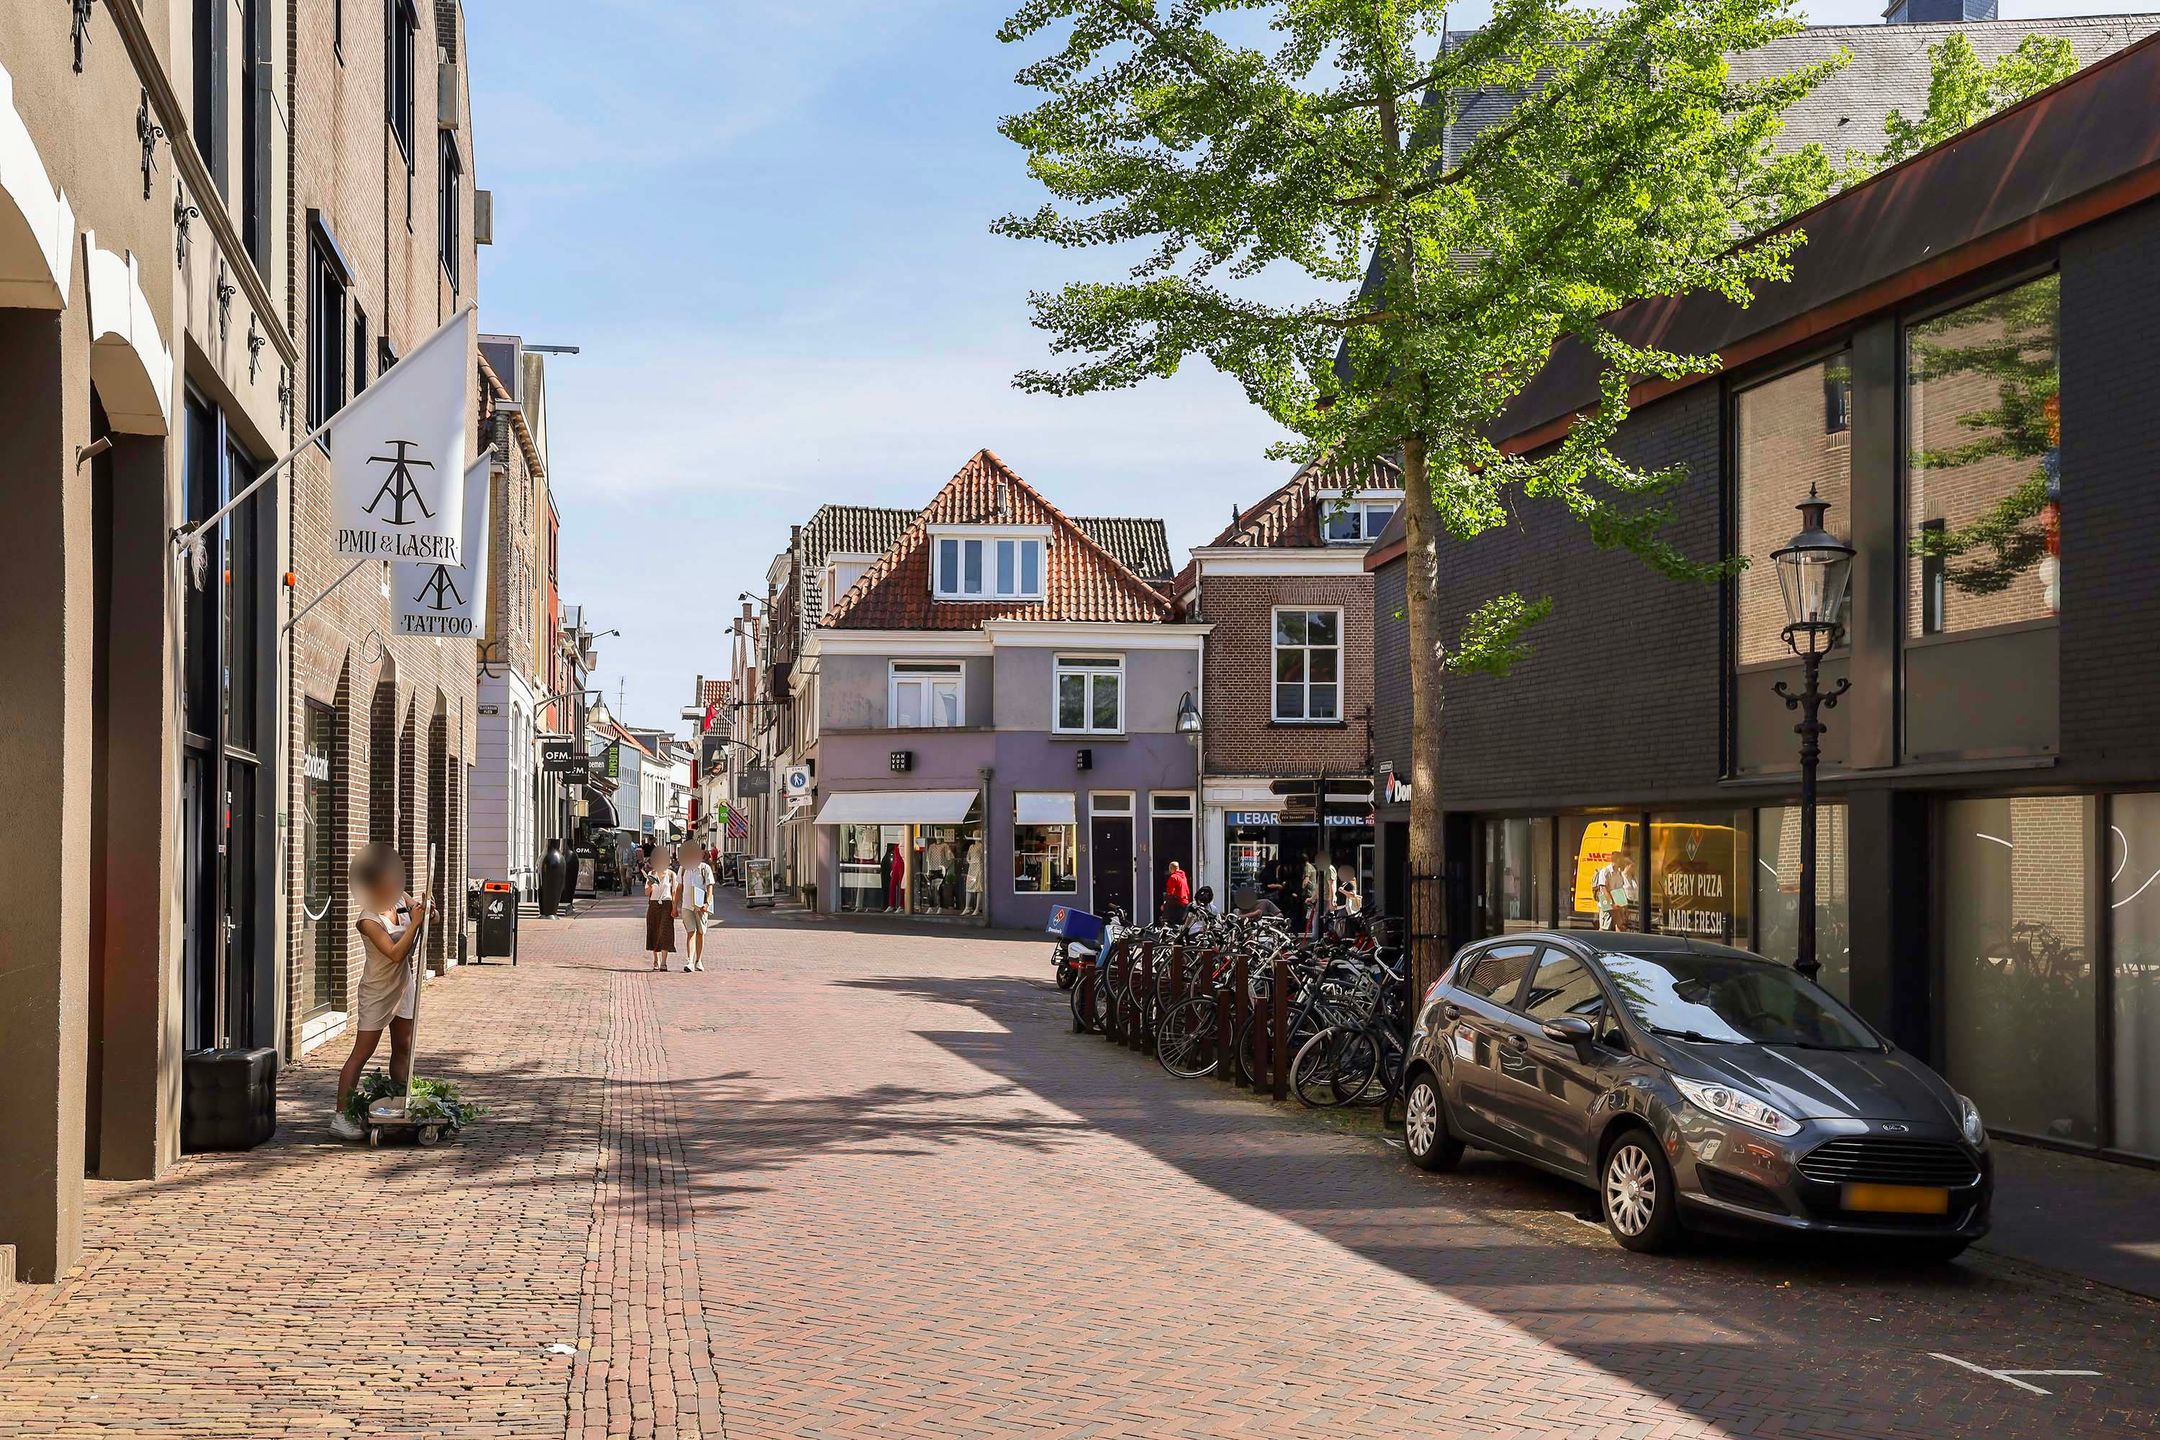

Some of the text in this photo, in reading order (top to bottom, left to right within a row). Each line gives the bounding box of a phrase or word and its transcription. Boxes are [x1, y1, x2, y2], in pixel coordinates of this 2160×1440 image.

[338, 529, 457, 561] PMU & LASER
[404, 615, 473, 635] TATTOO
[304, 744, 329, 781] abobank
[608, 747, 618, 777] BLOEMEN
[1236, 812, 1279, 825] LEBAR
[1324, 815, 1364, 825] HONE
[1667, 873, 1723, 898] EVERY PIZZA
[1668, 908, 1722, 935] MADE FRESH
